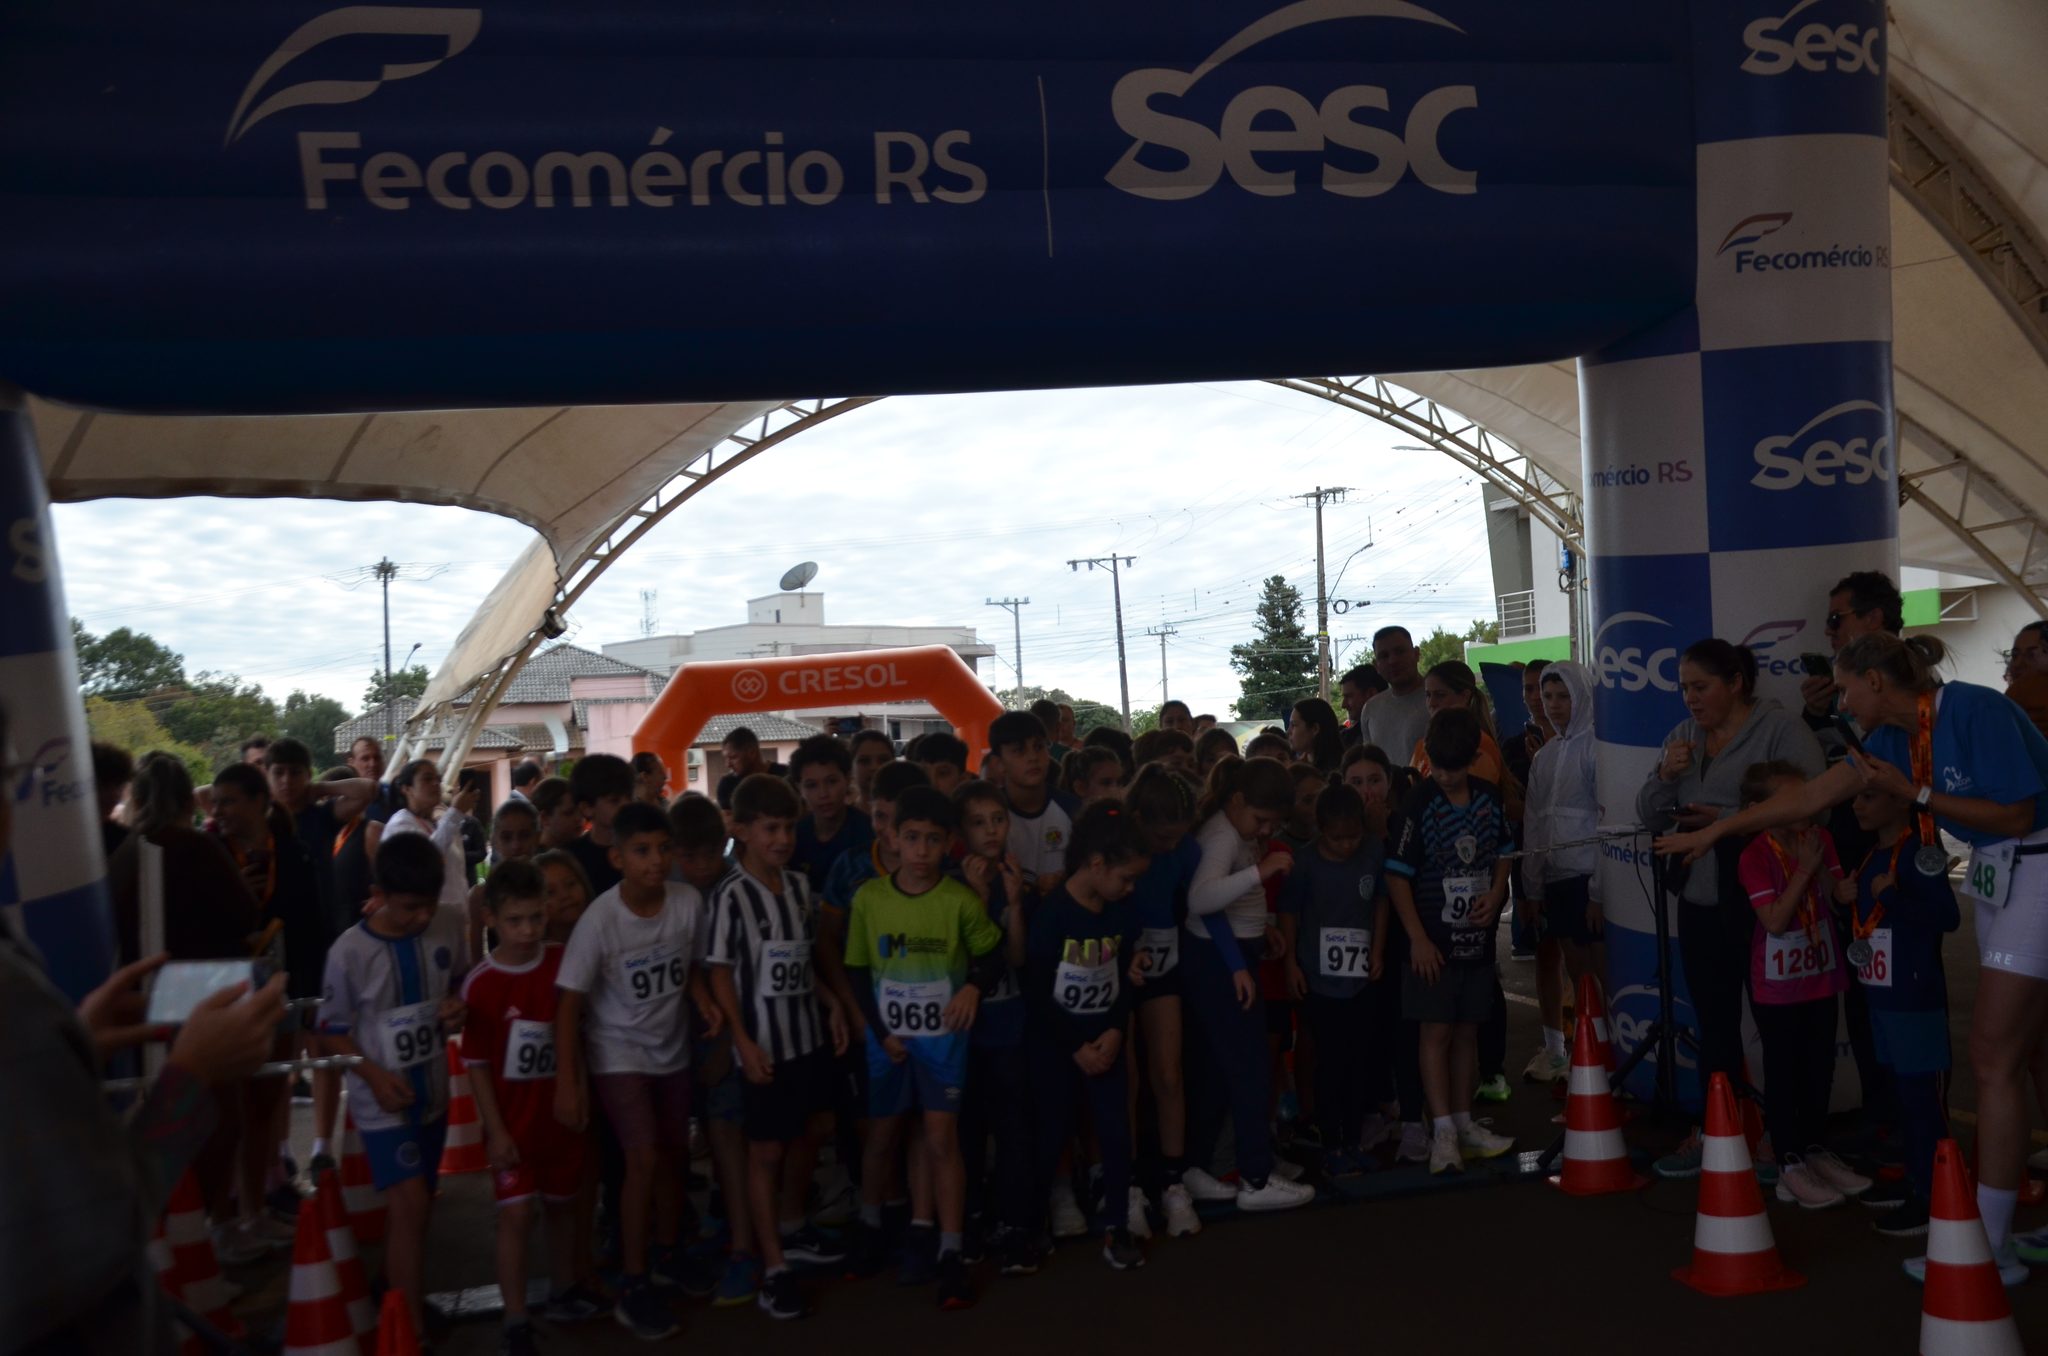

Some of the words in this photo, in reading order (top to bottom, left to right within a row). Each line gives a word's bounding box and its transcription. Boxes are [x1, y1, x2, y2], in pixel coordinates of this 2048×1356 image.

[1104, 66, 1479, 200] Sesc
[296, 126, 844, 210] Fecomércio
[873, 130, 988, 205] RS
[1736, 244, 1872, 273] Fecomércio
[1658, 459, 1693, 483] RS
[778, 663, 908, 695] CRESOL
[1972, 862, 1996, 898] 48
[1327, 945, 1370, 974] 973
[1772, 942, 1829, 976] 1280
[632, 957, 685, 999] 976
[1063, 981, 1112, 1009] 922
[888, 1000, 941, 1031] 968
[518, 1043, 557, 1074] 96
